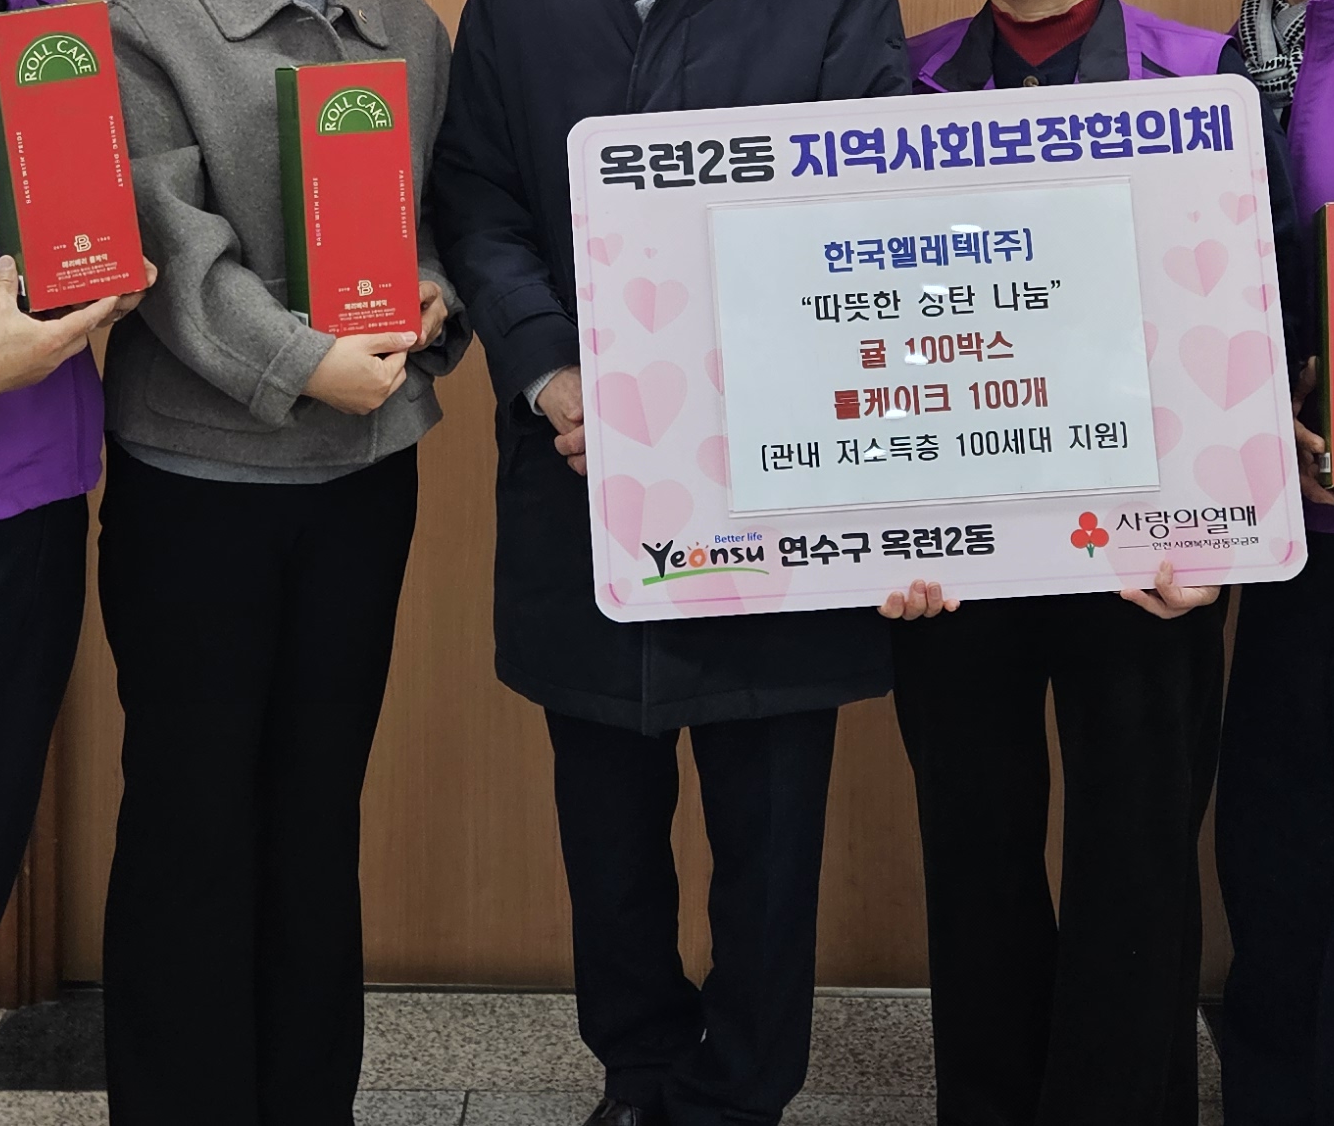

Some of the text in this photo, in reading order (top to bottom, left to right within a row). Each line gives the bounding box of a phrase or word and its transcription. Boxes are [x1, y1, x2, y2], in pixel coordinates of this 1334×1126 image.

[24, 40, 92, 81] ROLL CAKE
[324, 94, 387, 131] ROLL CAKE
[599, 104, 1235, 191] 옥련2동 지역사회보장협의체
[859, 330, 1015, 369] 귤 100박스
[833, 376, 1049, 420] 롤케이크 100개
[836, 434, 940, 466] 저소득층
[955, 425, 1053, 457] 100세대
[714, 531, 764, 545] Better life
[1116, 505, 1258, 540] 사랑의열매
[641, 539, 765, 579] Yeonsu
[778, 523, 996, 567] 연수구 옥련2동
[1152, 541, 1173, 551] 인천
